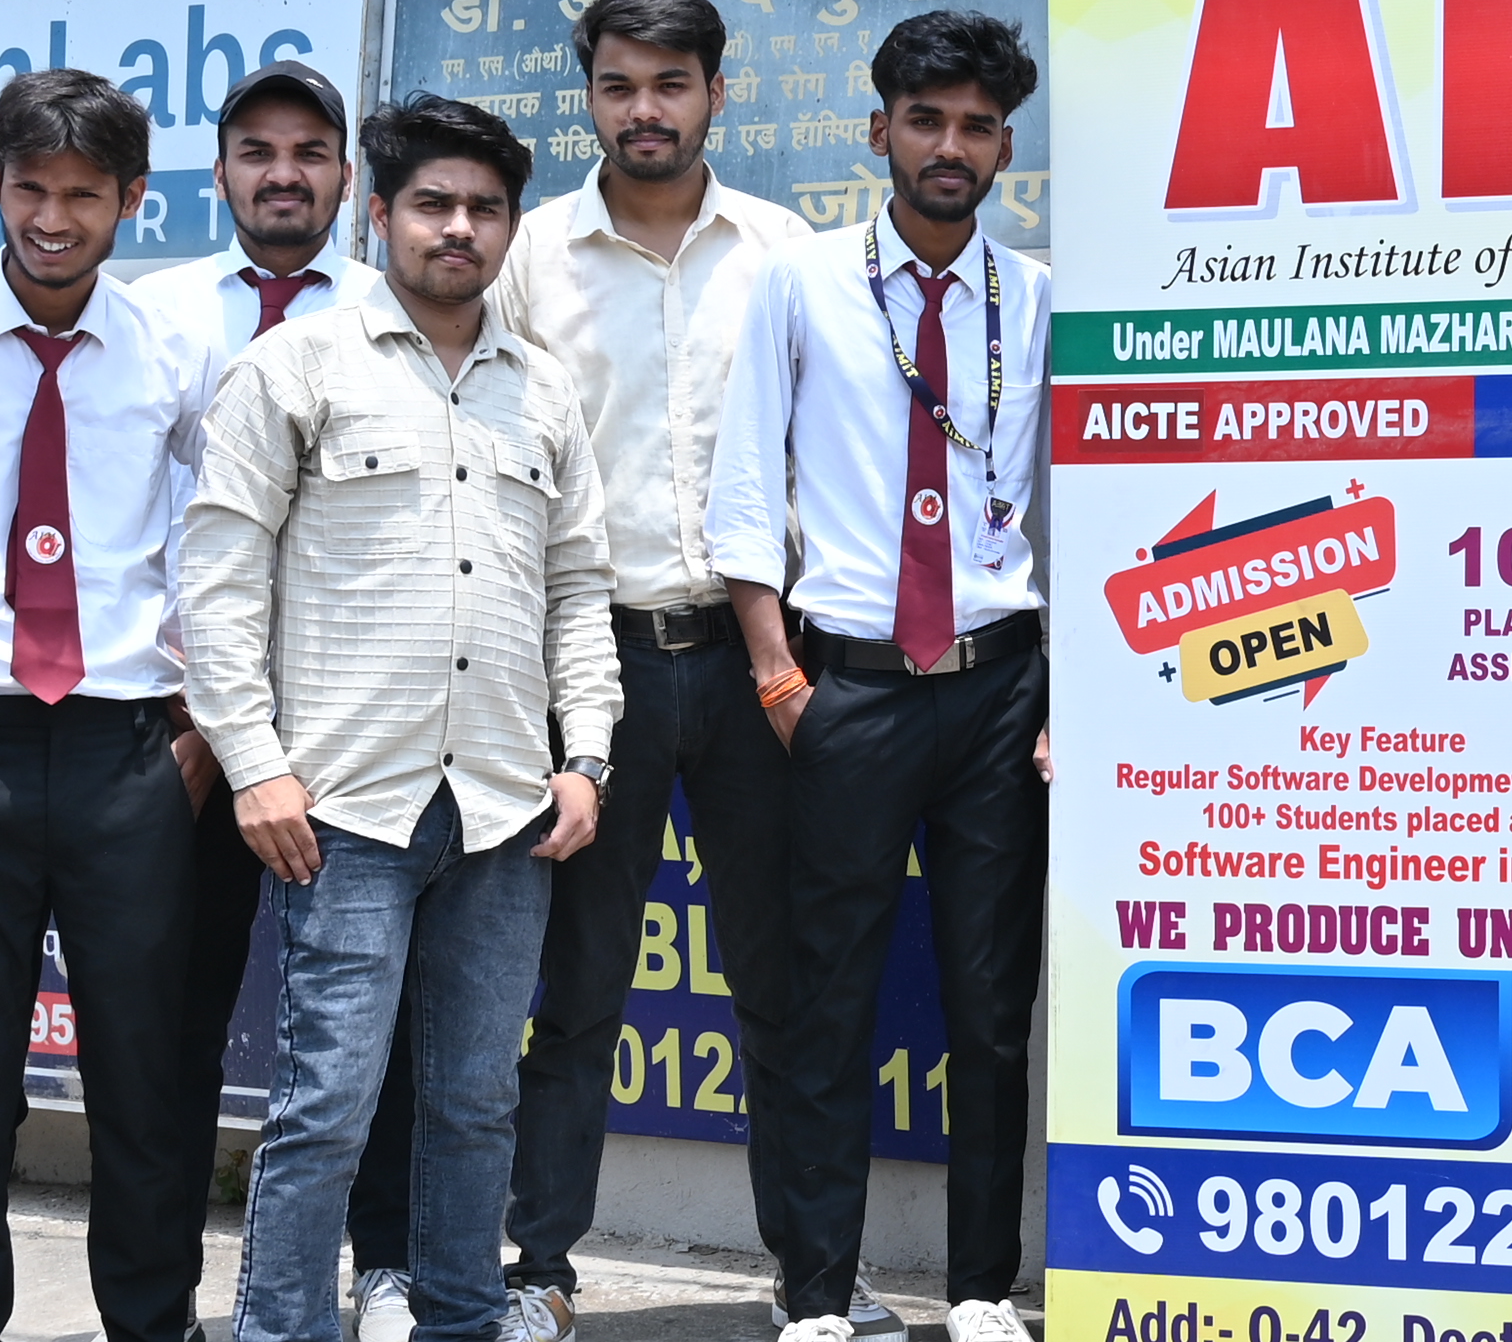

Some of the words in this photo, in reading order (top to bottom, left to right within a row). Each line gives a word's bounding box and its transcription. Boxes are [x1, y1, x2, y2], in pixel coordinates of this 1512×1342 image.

[779, 66, 827, 100] रोग
[738, 116, 778, 156] एंड
[1160, 243, 1278, 291] Asian
[1289, 239, 1463, 283] Institute
[1112, 321, 1204, 362] Under
[1212, 312, 1371, 360] MAULANA
[1083, 400, 1201, 442] AICTE
[1213, 398, 1430, 441] APPROVED
[1136, 525, 1382, 630] ADMISSION
[1208, 611, 1334, 678] OPEN
[1299, 725, 1351, 759] Key
[1359, 725, 1467, 755] Feature
[1115, 762, 1220, 797] Regular
[1226, 764, 1350, 795] Software
[1202, 803, 1267, 832] 100+
[1275, 802, 1398, 834] Students
[1406, 804, 1501, 839] placed
[1138, 840, 1306, 879] Software
[1318, 844, 1487, 891] Engineer
[1115, 900, 1187, 952] WE
[1213, 902, 1431, 957] PRODUCE
[1158, 997, 1469, 1114] BCA
